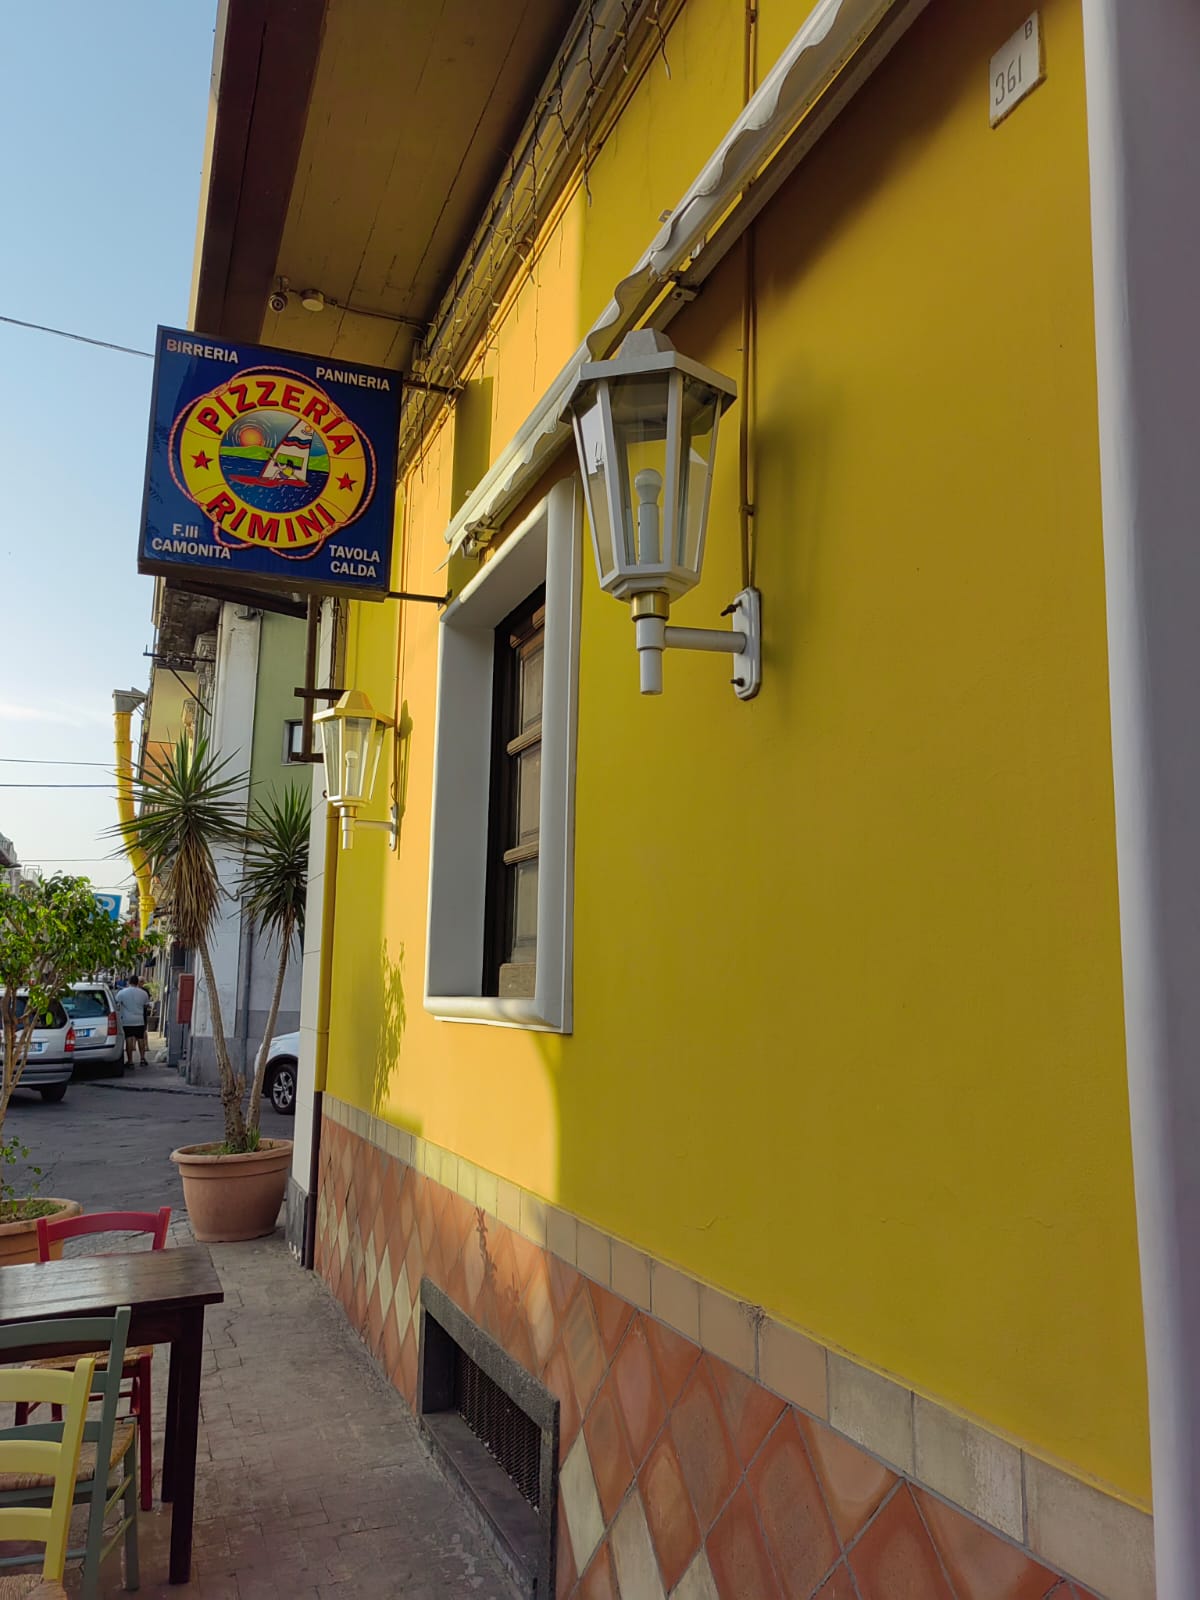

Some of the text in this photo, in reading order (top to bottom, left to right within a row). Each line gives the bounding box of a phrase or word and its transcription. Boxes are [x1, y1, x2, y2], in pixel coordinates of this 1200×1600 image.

[1024, 20, 1033, 40] B
[995, 54, 1022, 106] 361
[166, 338, 239, 364] BIRRERIA
[316, 366, 391, 391] PANINERIA
[196, 380, 355, 455] PIZZERIA
[206, 491, 337, 543] RIMINI
[151, 537, 231, 560] CAMONITA
[329, 544, 381, 563] TAVOLA
[330, 561, 377, 578] CALDA
